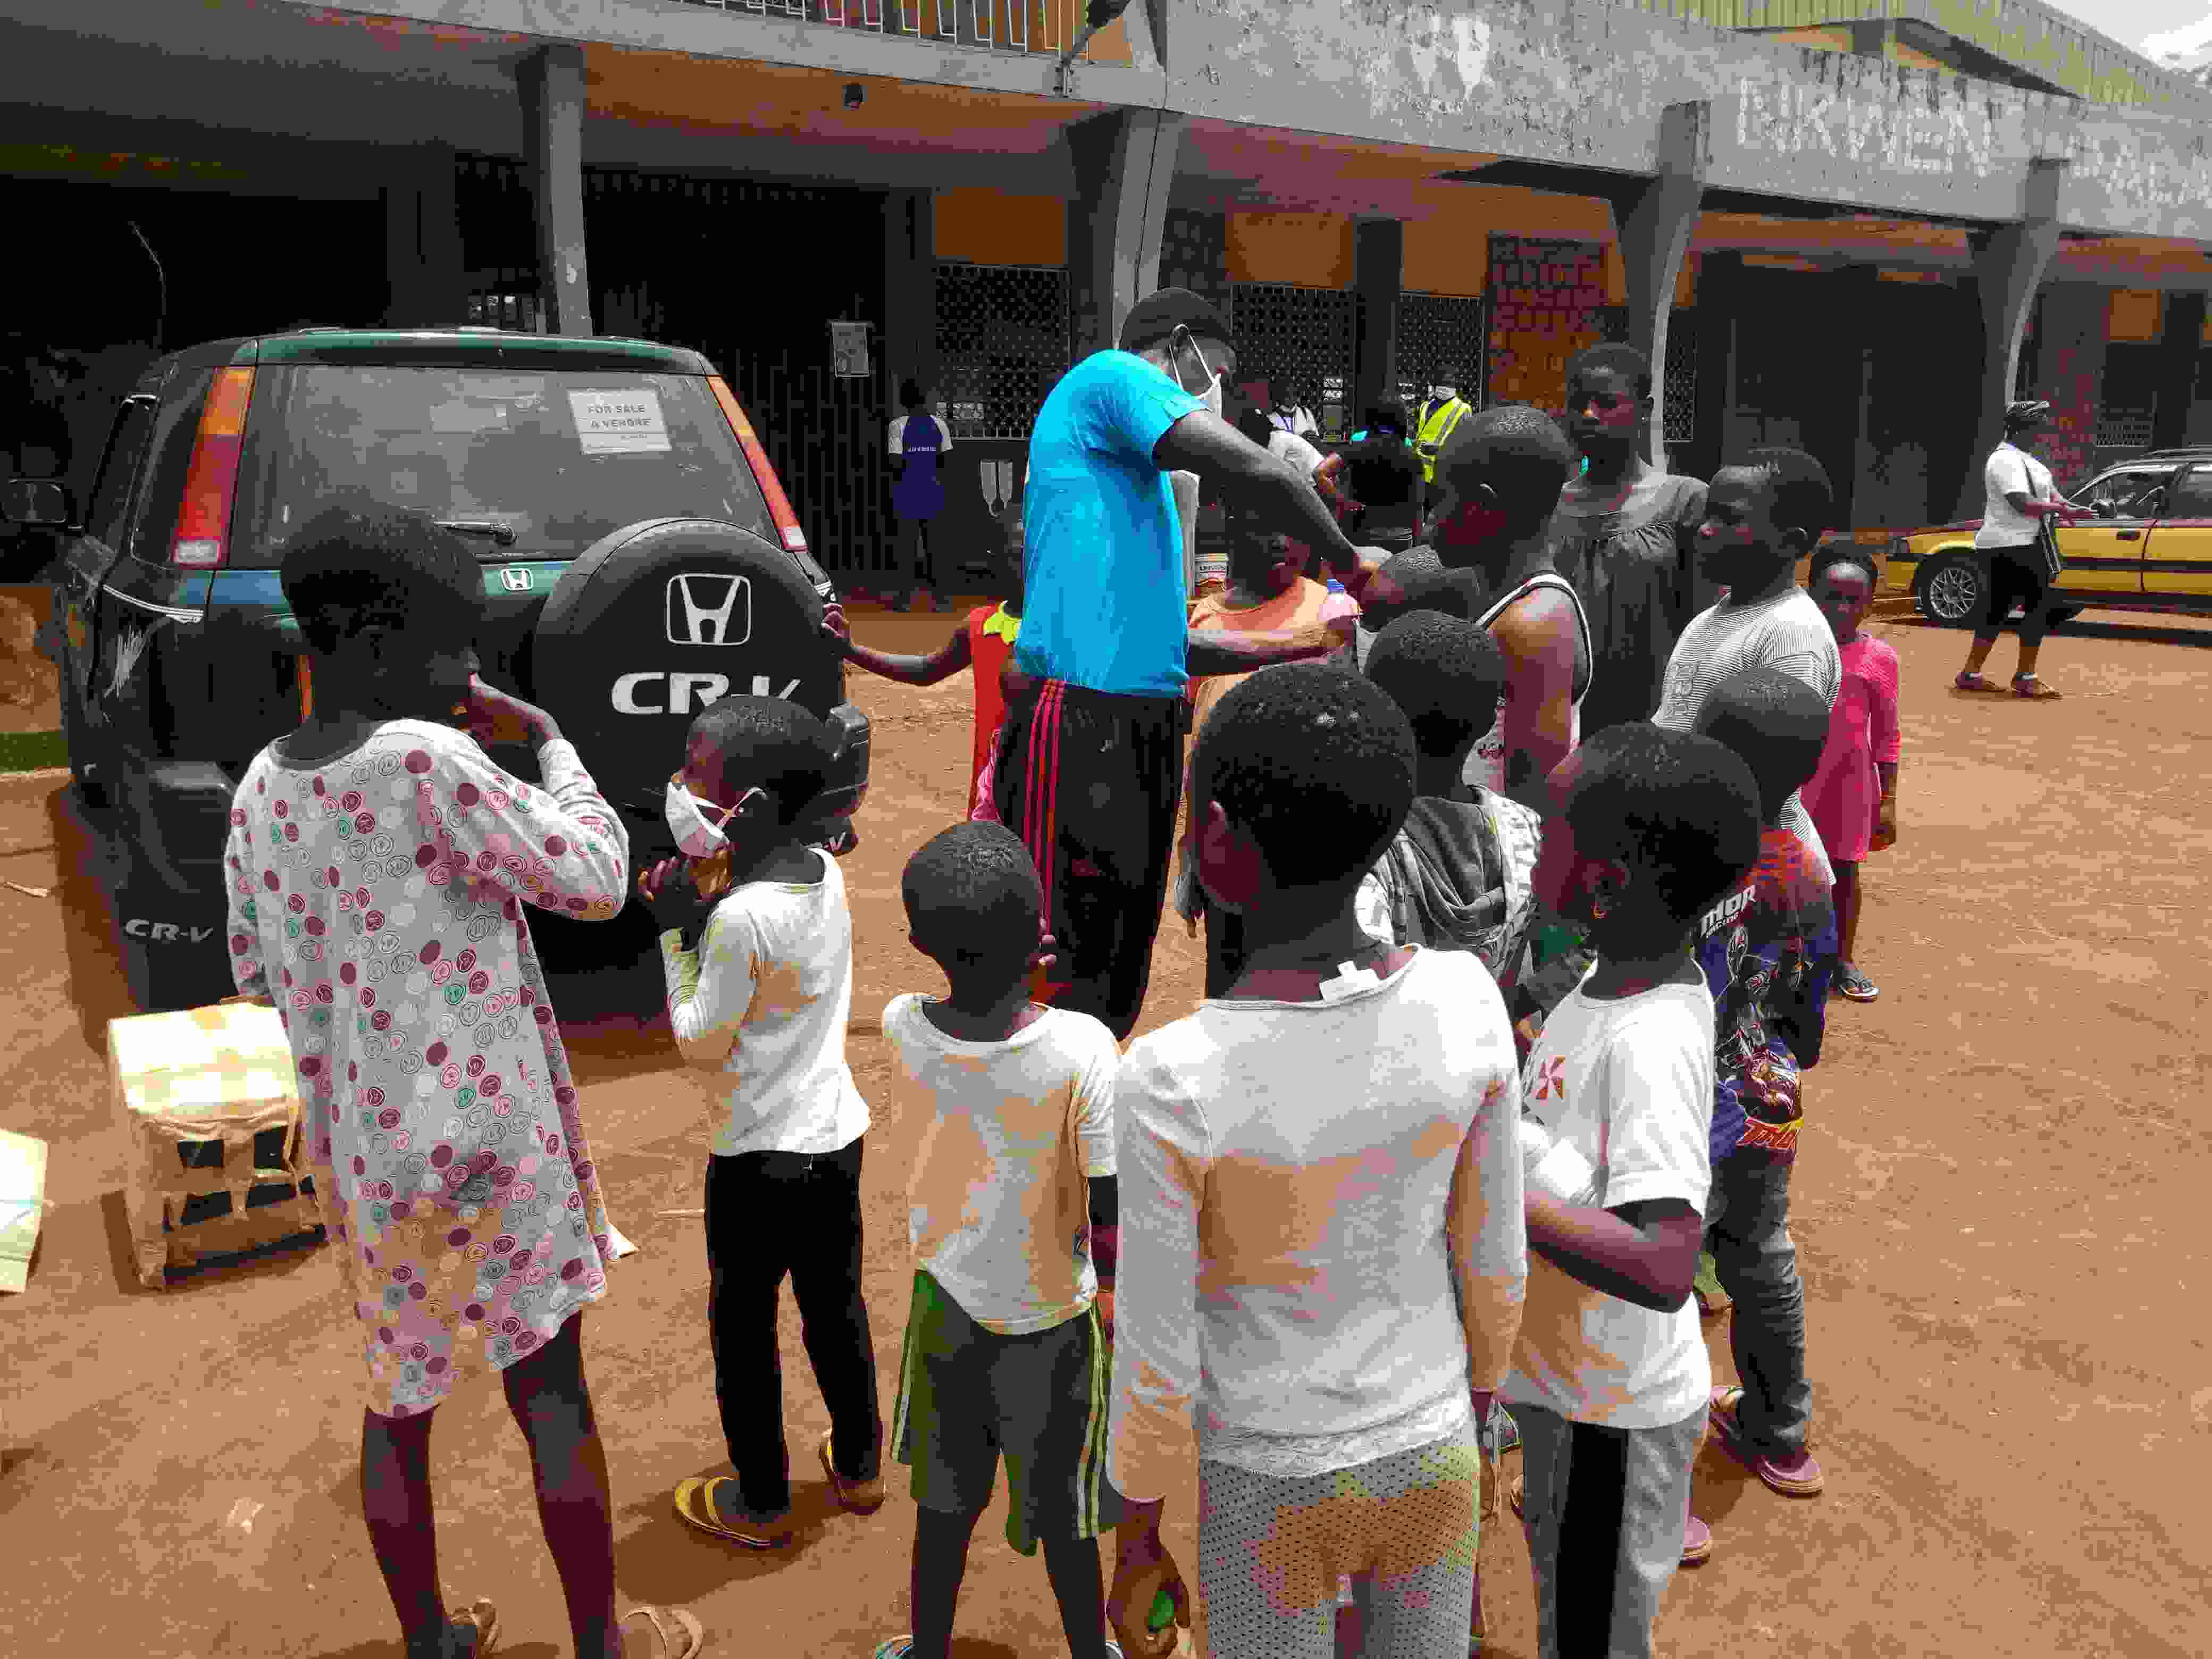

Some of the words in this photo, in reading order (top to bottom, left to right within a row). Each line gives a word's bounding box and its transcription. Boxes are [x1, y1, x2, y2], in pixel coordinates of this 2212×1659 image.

[616, 405, 647, 413] SALE
[611, 672, 801, 714] CRV
[1700, 884, 1756, 939] THOR
[125, 919, 213, 943] CR-V
